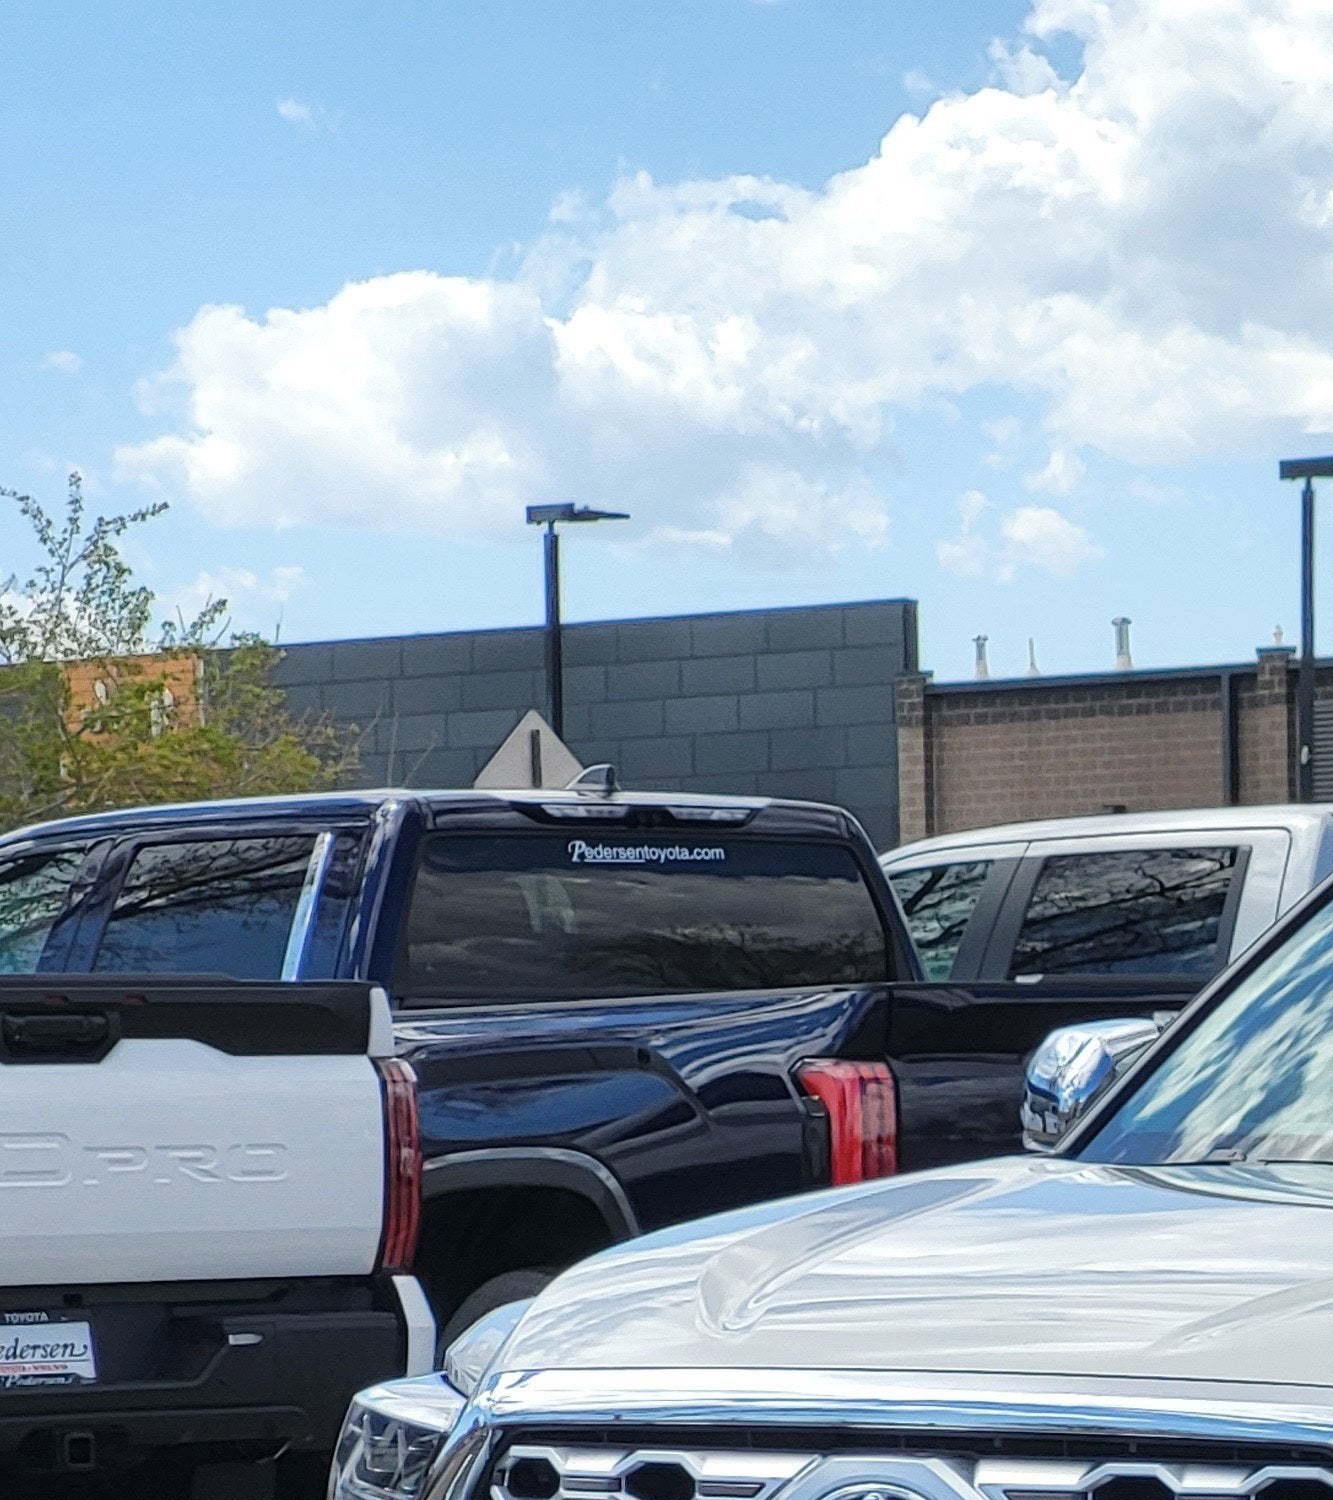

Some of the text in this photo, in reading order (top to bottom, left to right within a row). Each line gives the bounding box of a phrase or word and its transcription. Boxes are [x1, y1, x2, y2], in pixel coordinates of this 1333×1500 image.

[567, 840, 725, 863] Pedersentoyota.com
[4, 1311, 50, 1324] TOYOTA
[0, 1337, 88, 1360] edersen
